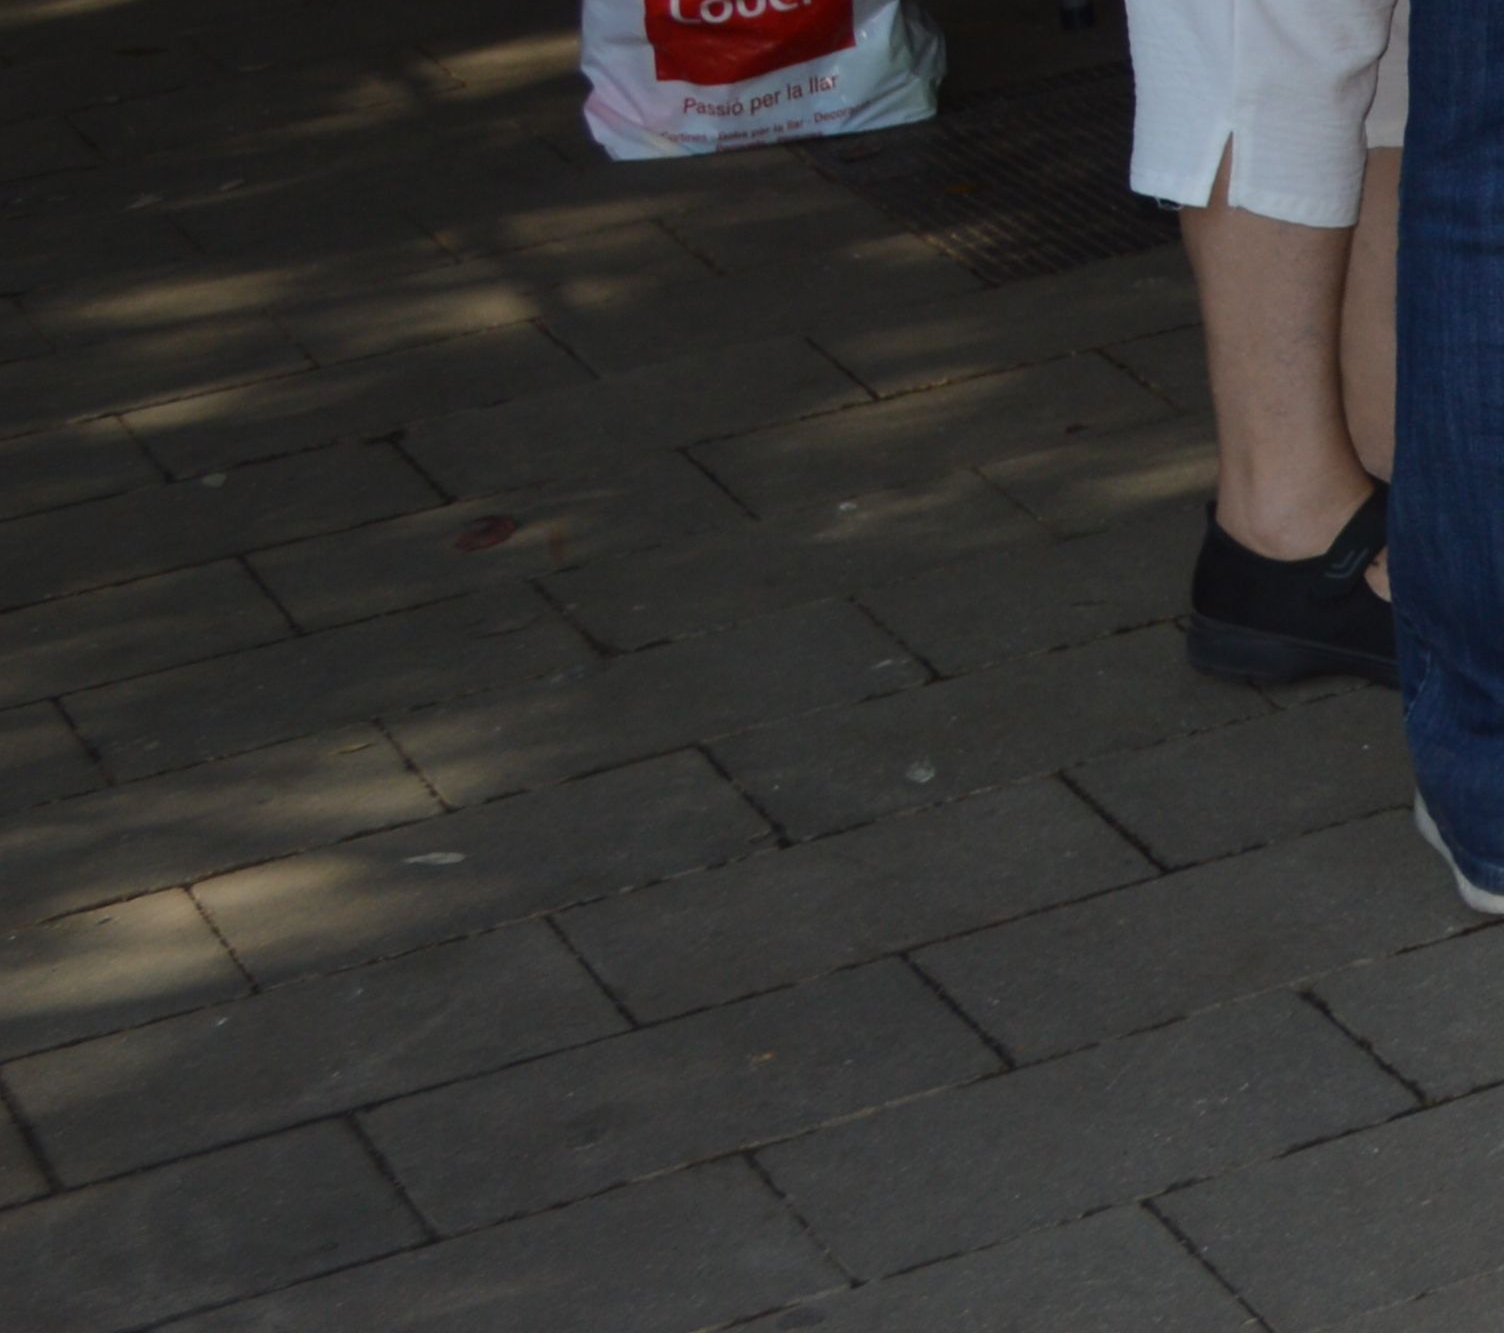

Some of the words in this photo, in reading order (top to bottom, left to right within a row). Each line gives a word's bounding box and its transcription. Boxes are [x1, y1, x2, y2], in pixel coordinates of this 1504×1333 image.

[683, 97, 744, 117] Passió
[750, 89, 781, 115] per
[787, 84, 804, 101] la
[809, 75, 838, 96] llar
